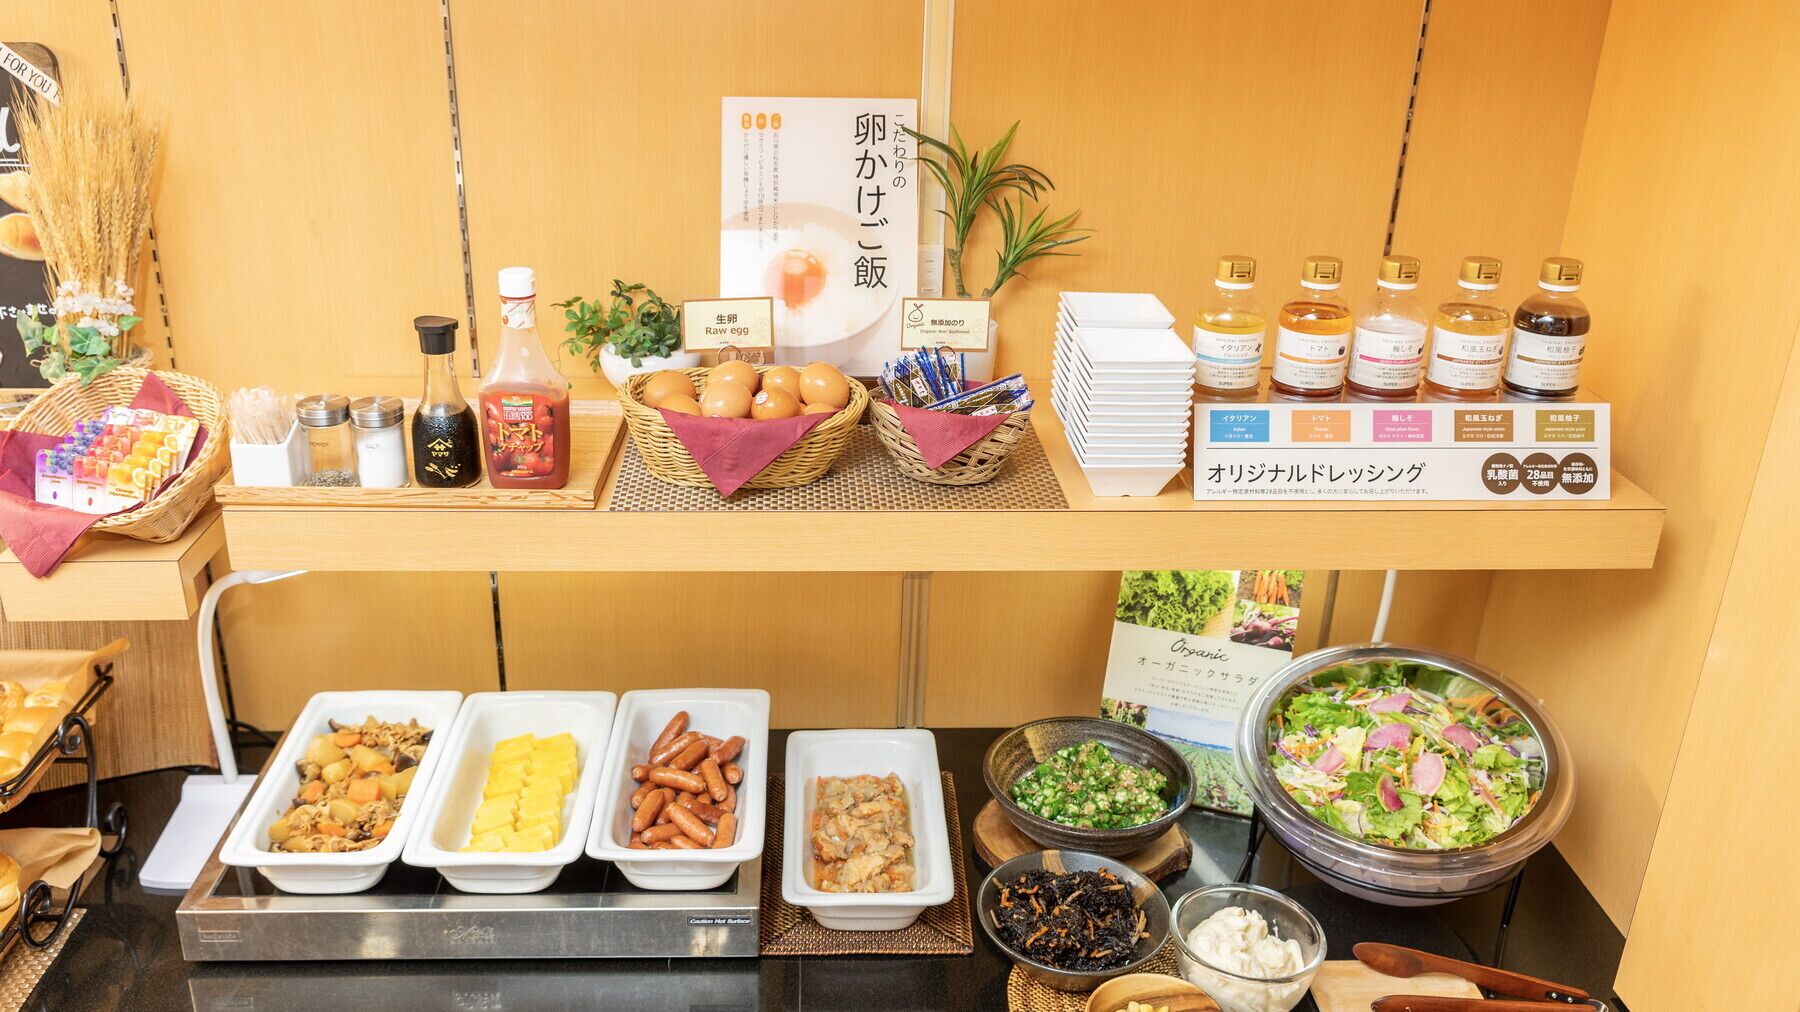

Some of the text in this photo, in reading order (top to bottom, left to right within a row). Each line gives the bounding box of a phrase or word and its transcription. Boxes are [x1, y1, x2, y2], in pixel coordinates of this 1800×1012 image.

[3, 53, 52, 93] FOR YOU
[854, 113, 888, 289] 卵かけご飯
[716, 314, 738, 325] 生卵
[930, 319, 965, 327] 無添加のり
[705, 327, 749, 336] Raw egg
[1219, 344, 1253, 352] イタリアン
[1392, 345, 1414, 353] 梅しそ
[1461, 344, 1498, 353] 和風玉ねぎ
[1547, 345, 1576, 353] 和風柚子
[1465, 414, 1503, 422] 和風玉ねぎ
[1550, 414, 1580, 422] 和風柚子
[497, 422, 544, 442] トマト
[499, 442, 545, 453] ケチャップ
[1207, 462, 1427, 484] オリジナルドレッシング
[1486, 469, 1519, 480] 乳酸菌
[1527, 469, 1554, 480] 28品目
[1561, 472, 1594, 484] 無添加
[1170, 637, 1230, 662] Organic
[1137, 656, 1259, 687] オーガニックサラダ
